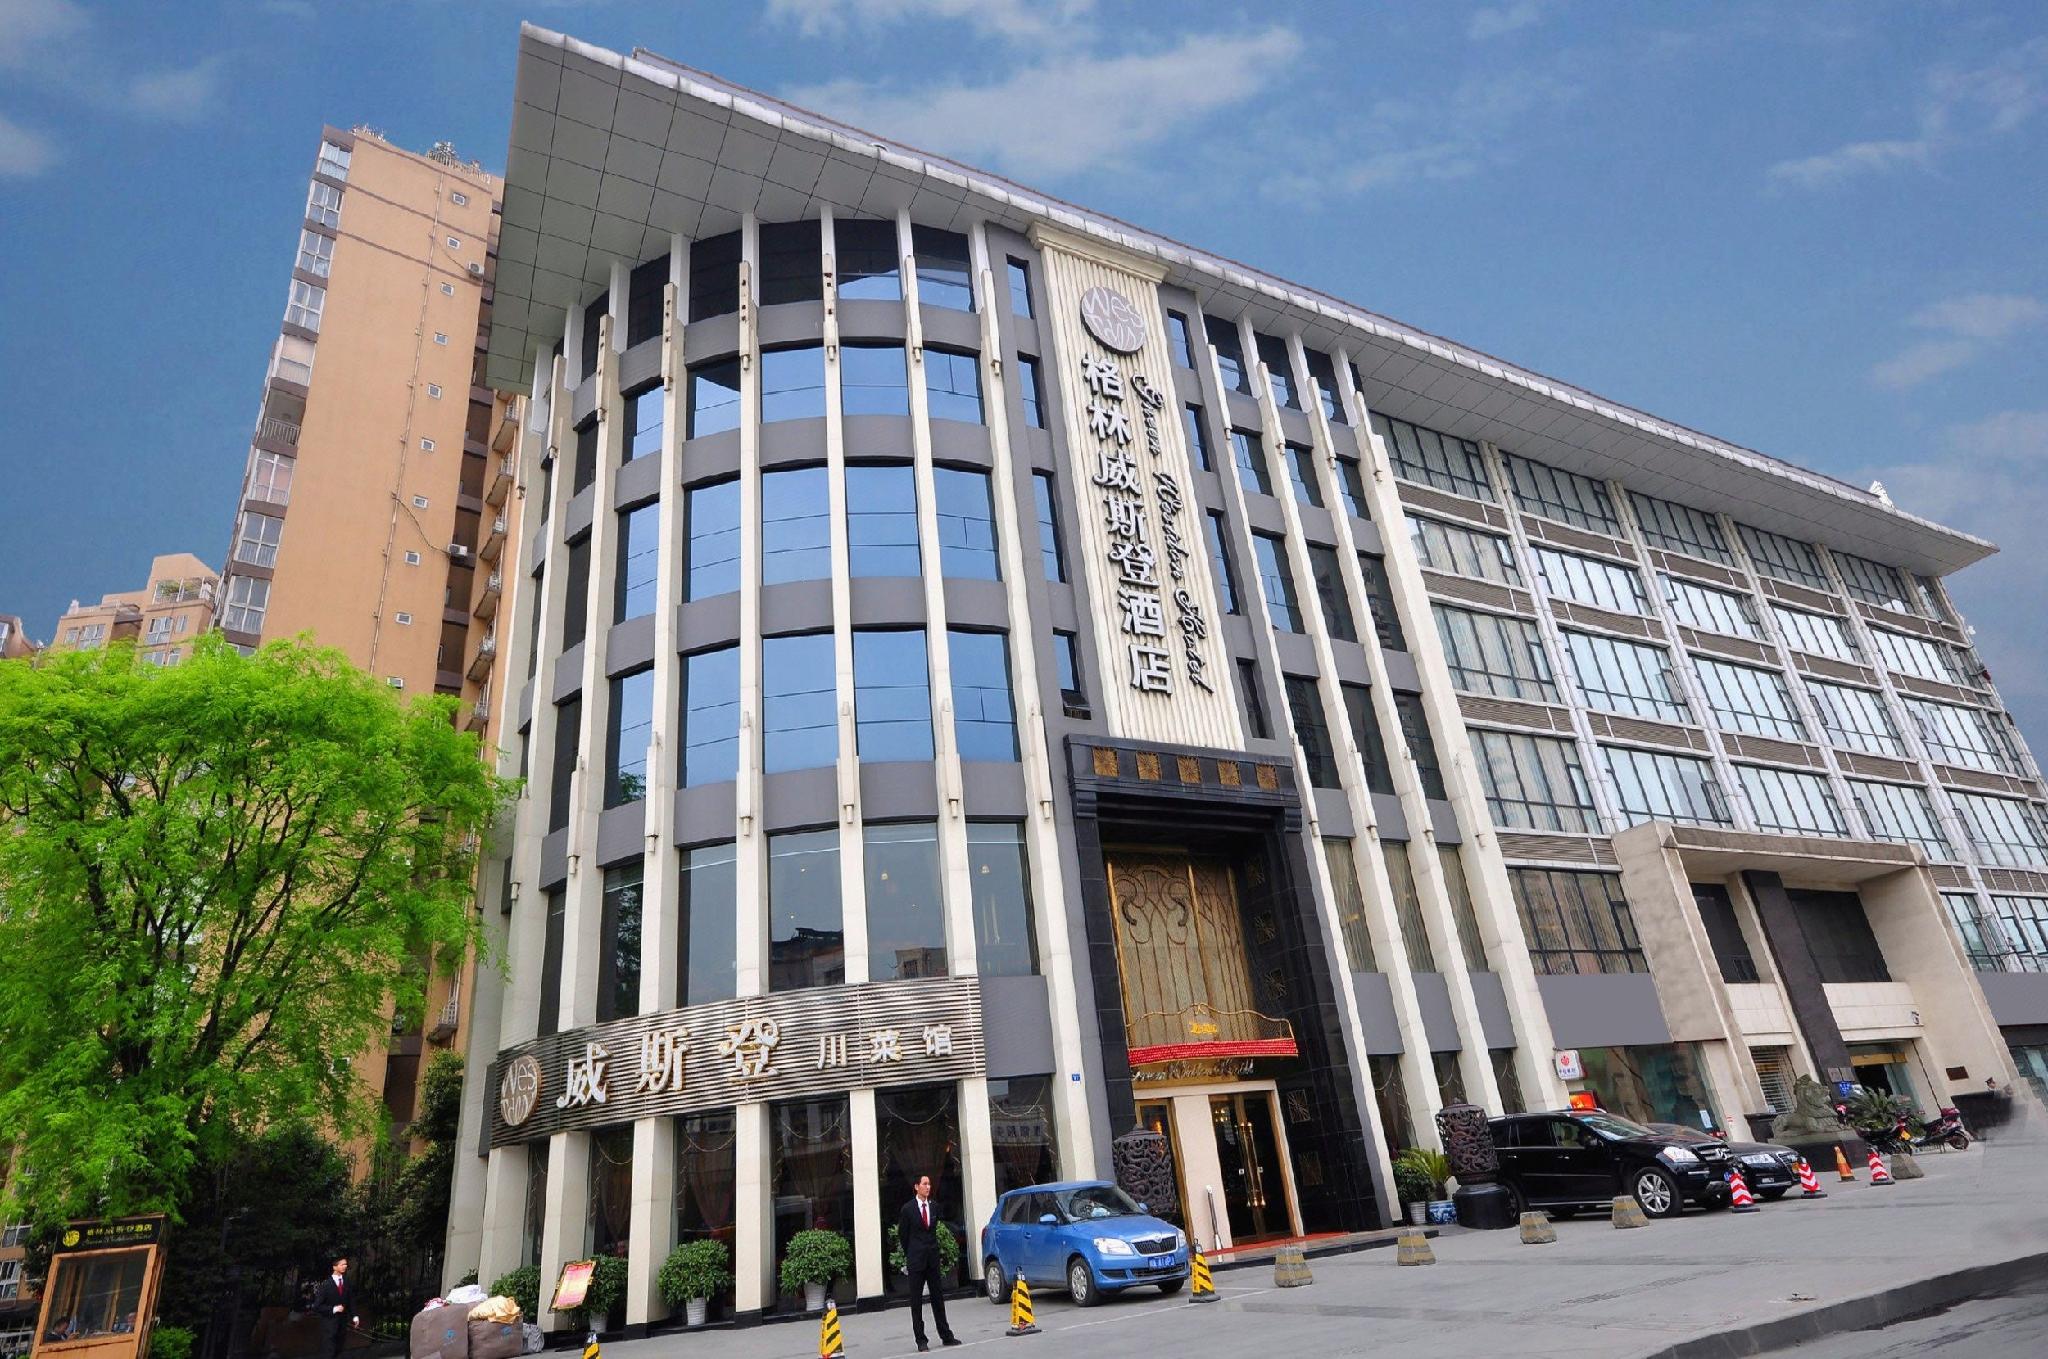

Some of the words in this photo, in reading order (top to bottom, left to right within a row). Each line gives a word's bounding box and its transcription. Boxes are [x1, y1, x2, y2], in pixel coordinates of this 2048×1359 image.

[1081, 352, 1173, 696] 格林威斯登酒店
[1131, 373, 1164, 456] Green
[1174, 587, 1214, 695] Hotel
[556, 1017, 782, 1109] 威斯登
[816, 1024, 953, 1070] 川菜馆
